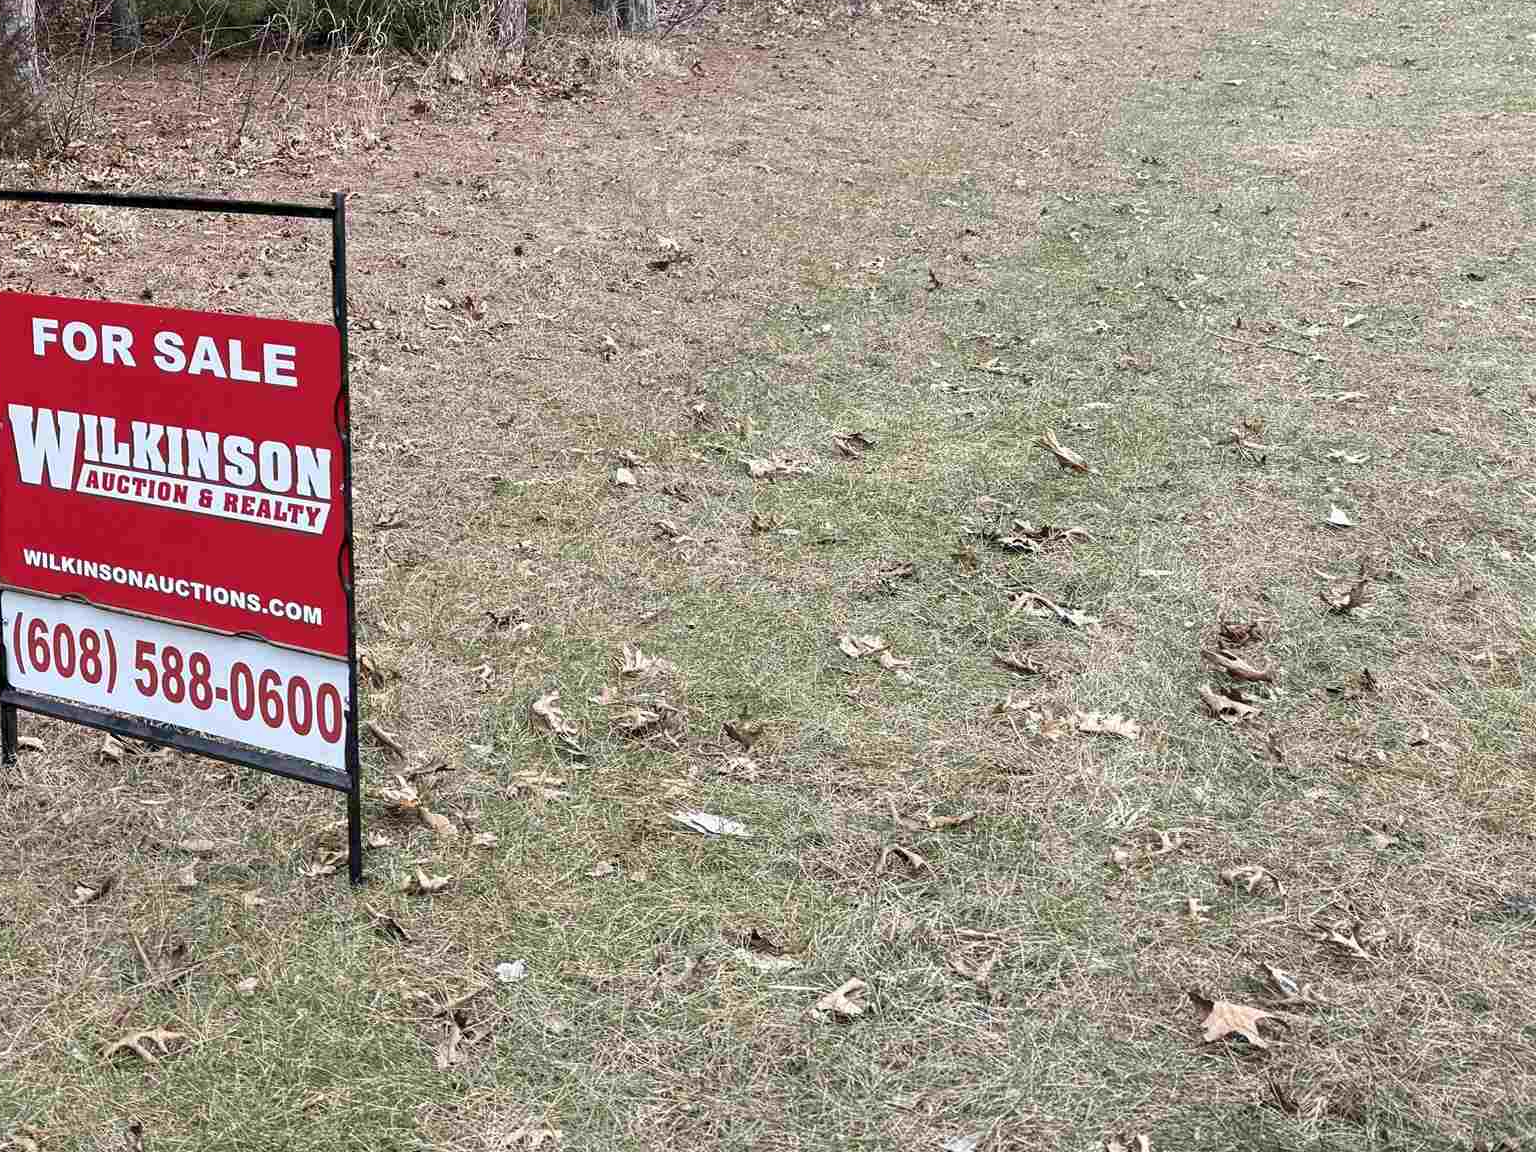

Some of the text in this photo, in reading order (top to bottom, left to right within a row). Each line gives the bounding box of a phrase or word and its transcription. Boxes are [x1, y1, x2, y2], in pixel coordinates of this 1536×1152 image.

[31, 317, 299, 388] FOR SALE
[7, 403, 333, 499] WILKINSON
[85, 471, 324, 528] AUCTION & REALTY
[23, 549, 323, 626] WILKINSONAUCTIONS.COM
[13, 611, 343, 744] (608) 588-0600
